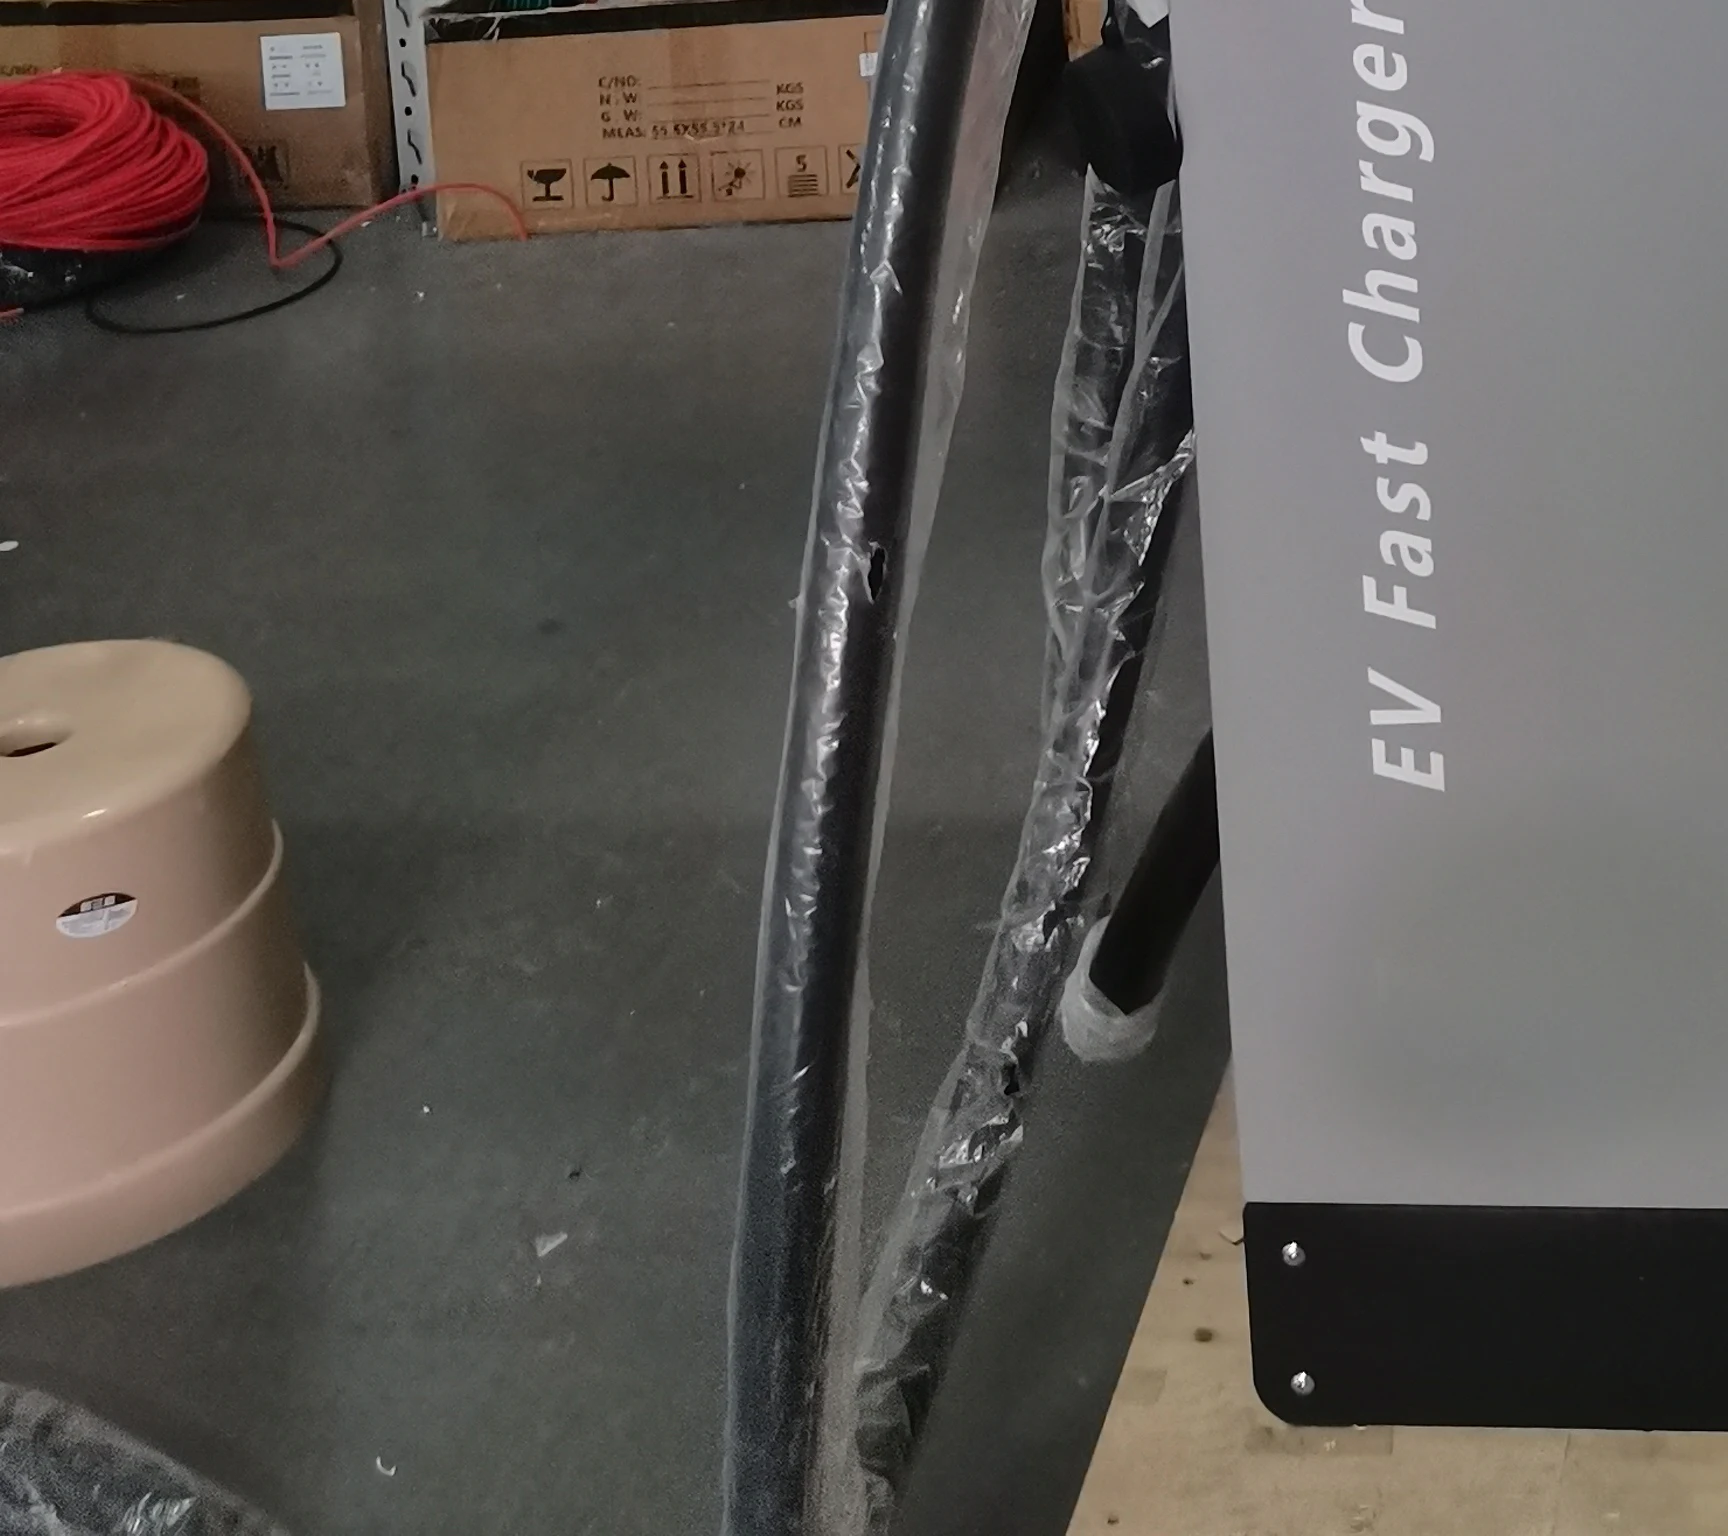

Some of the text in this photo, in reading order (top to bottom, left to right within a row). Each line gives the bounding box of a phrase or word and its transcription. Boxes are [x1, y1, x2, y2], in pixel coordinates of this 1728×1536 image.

[776, 82, 805, 96] KGS
[776, 99, 805, 113] KGS
[778, 115, 803, 129] CM
[1360, 430, 1437, 630] Fast
[1367, 666, 1445, 792] EV
